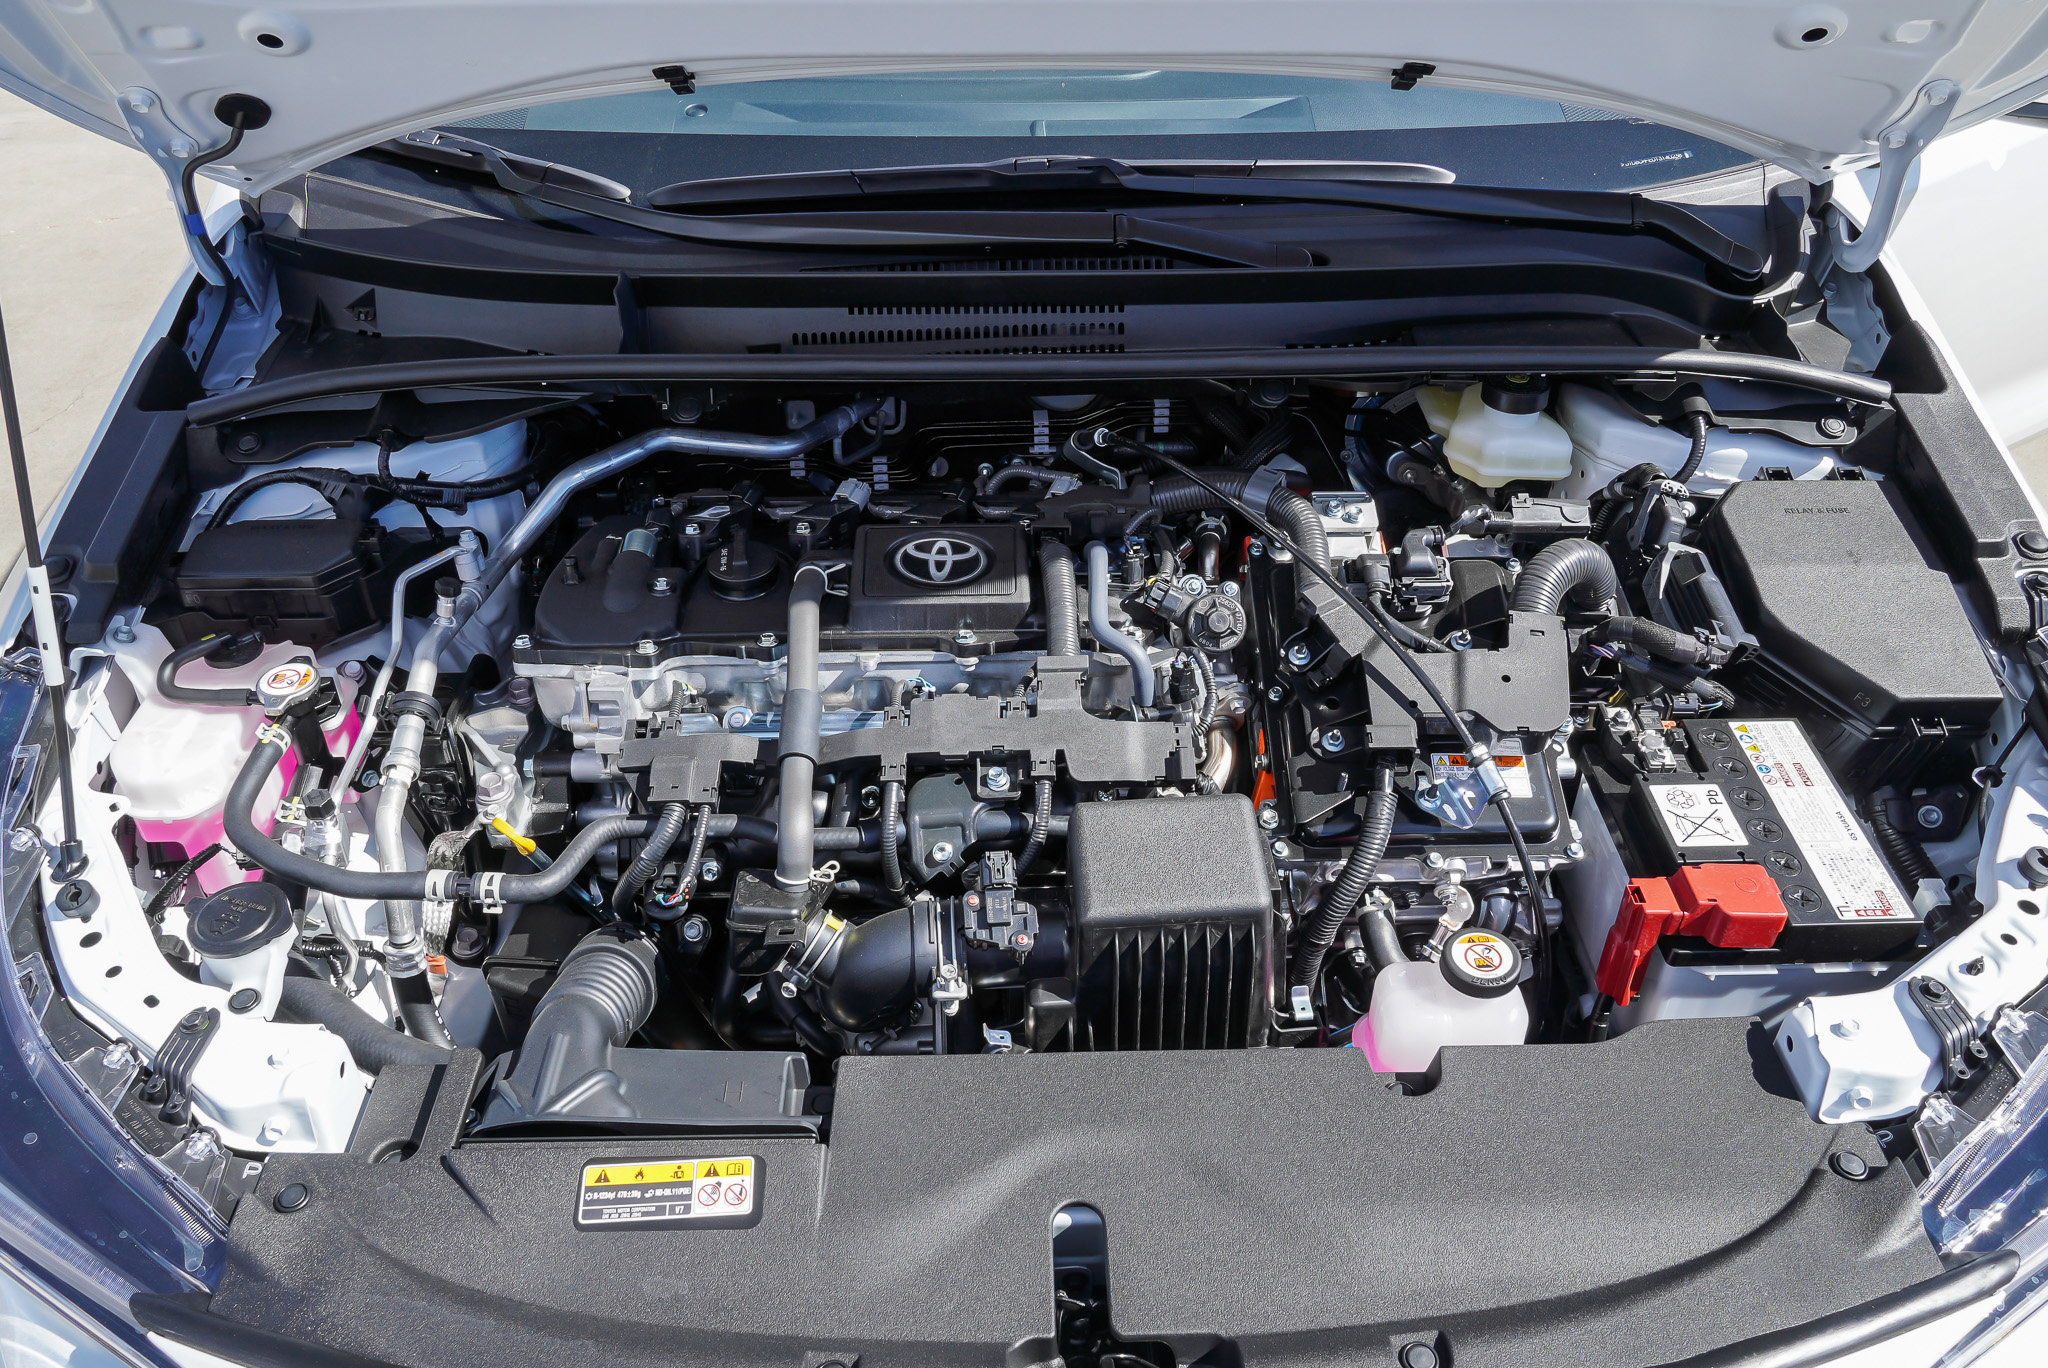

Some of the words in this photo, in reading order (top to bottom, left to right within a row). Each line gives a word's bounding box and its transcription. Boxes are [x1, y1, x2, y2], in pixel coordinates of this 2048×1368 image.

[1706, 790, 1722, 804] Pb
[1835, 811, 1853, 832] YUASA
[1849, 832, 1858, 841] GS
[675, 1205, 685, 1214] V7
